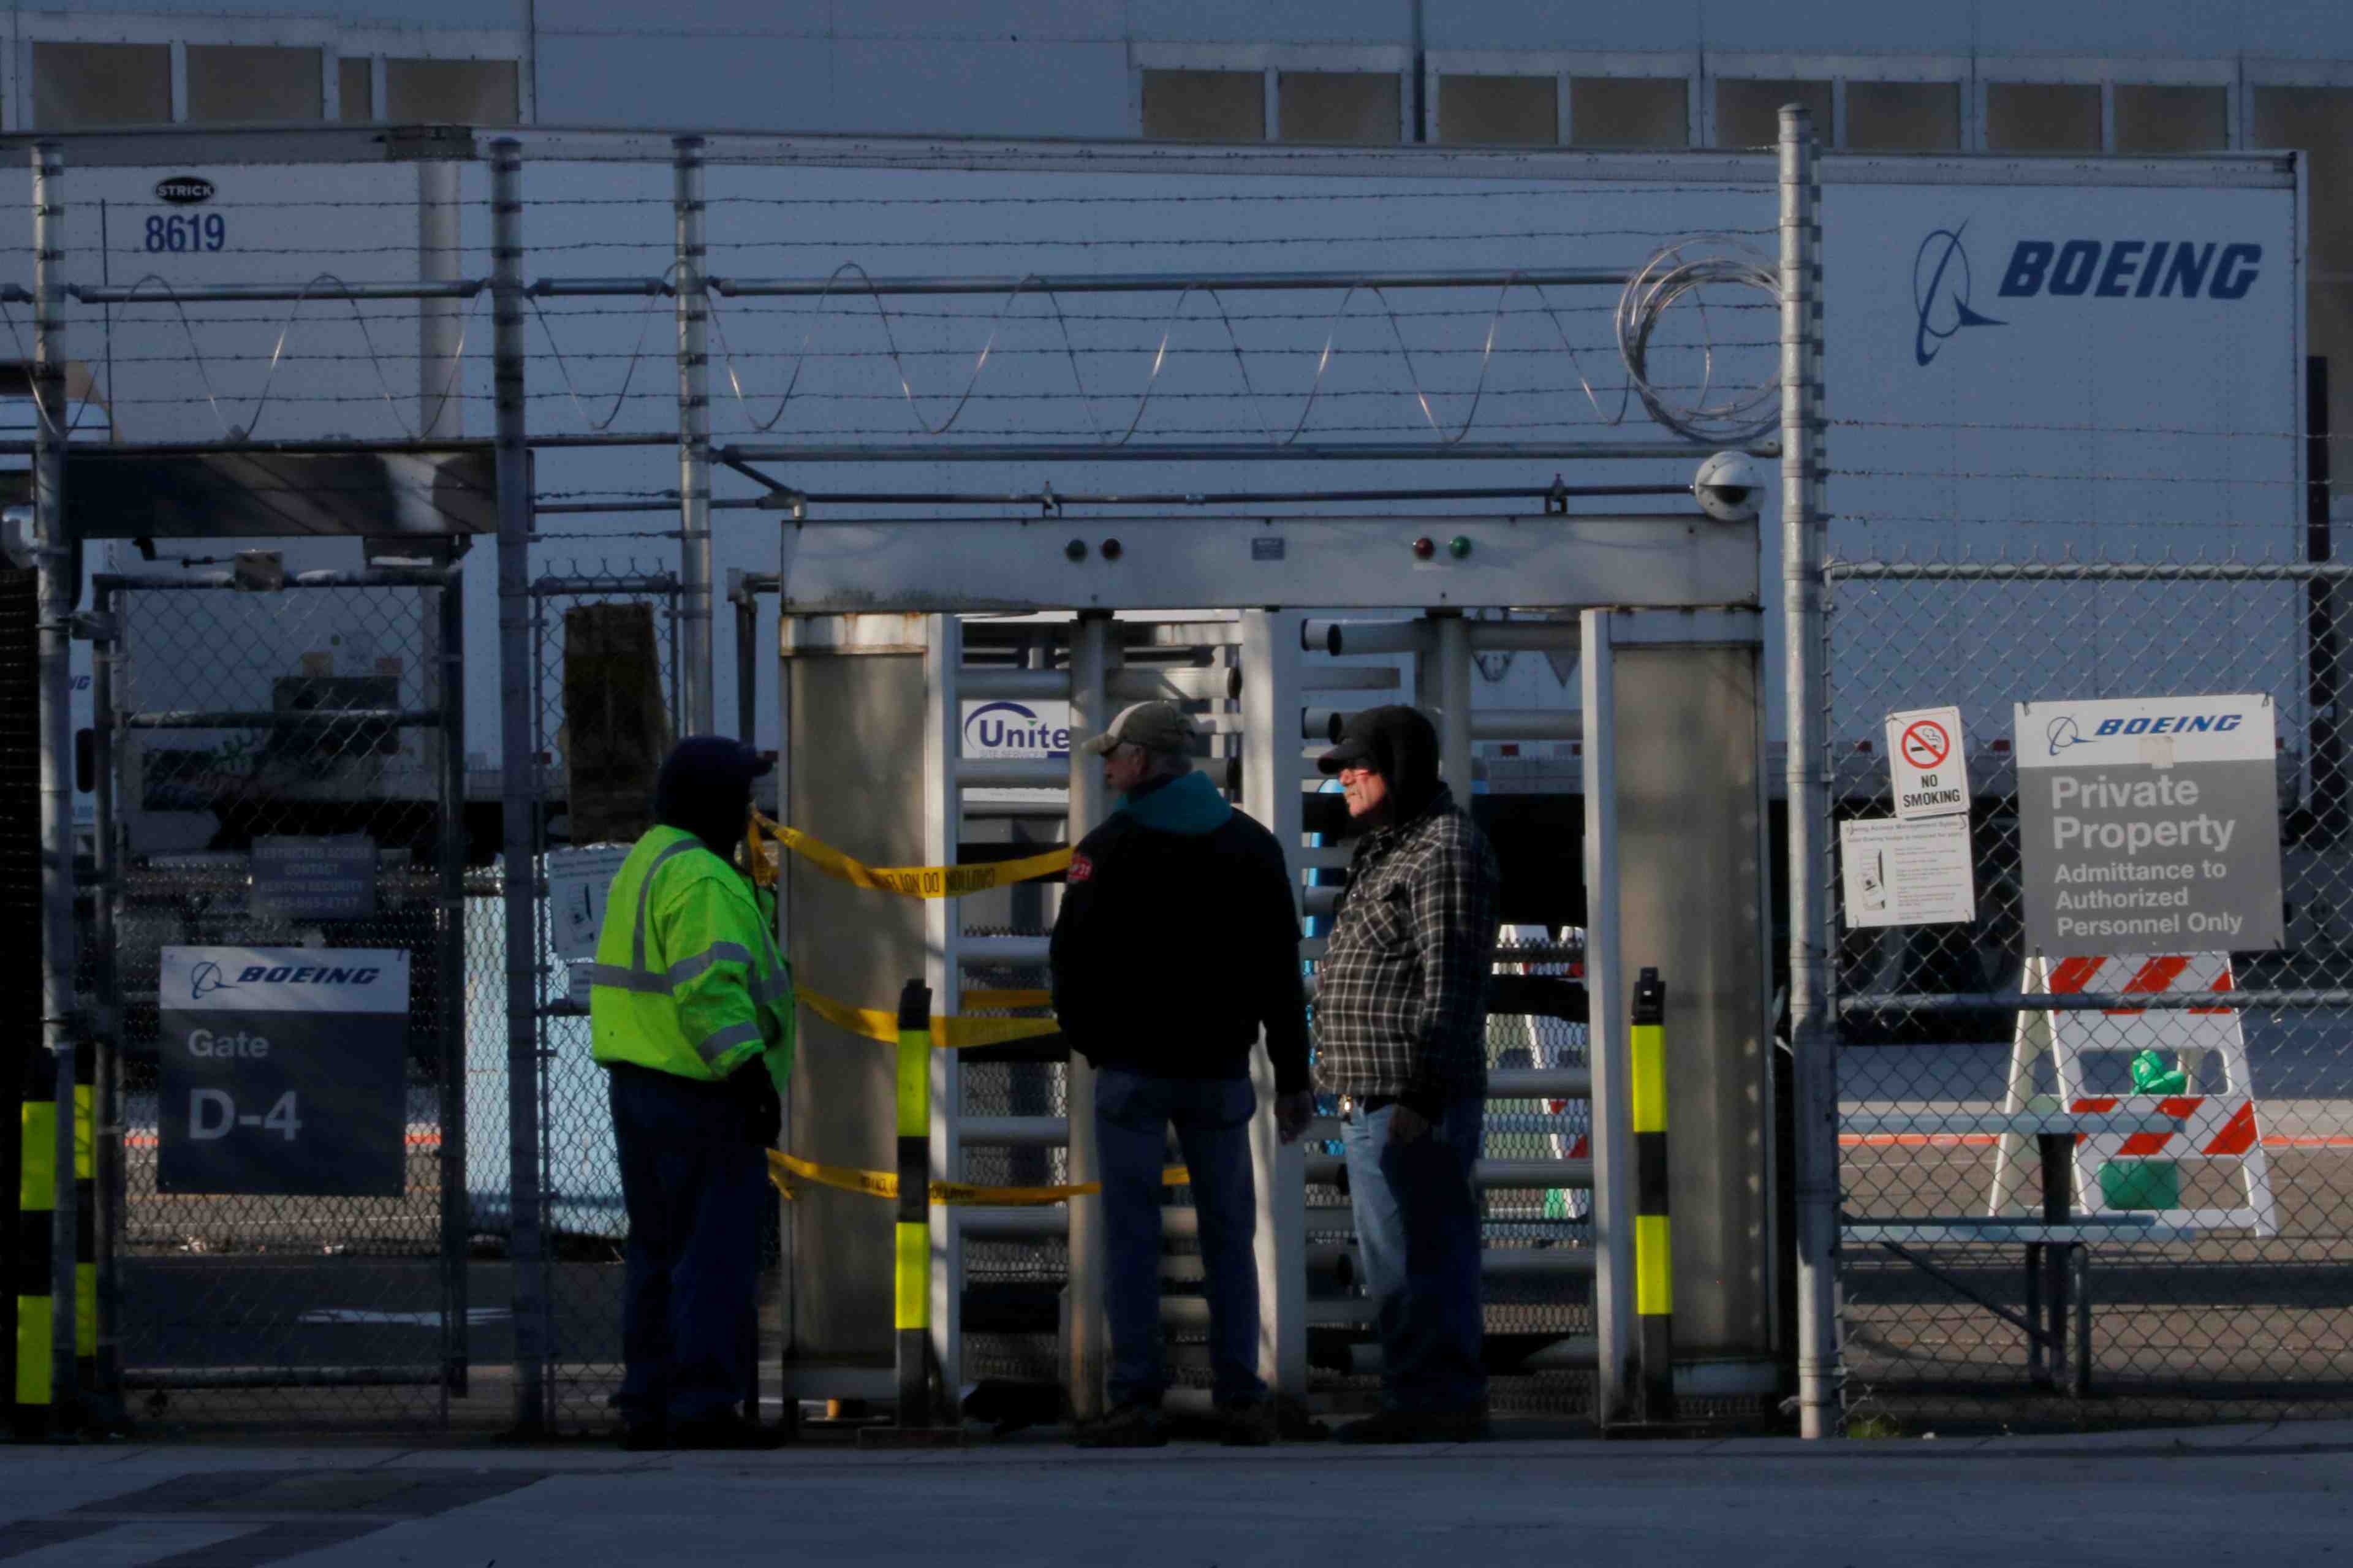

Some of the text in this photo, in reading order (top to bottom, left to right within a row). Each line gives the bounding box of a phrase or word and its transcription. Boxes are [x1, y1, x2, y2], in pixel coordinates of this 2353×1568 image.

[157, 185, 211, 197] STRICK
[145, 213, 225, 253] 8619
[1998, 240, 2262, 300] BOEING
[980, 720, 1069, 749] Unite
[2094, 714, 2243, 737] BOEING
[1921, 774, 1938, 788] NO
[2052, 775, 2199, 809] Private
[1903, 789, 1960, 808] SMOKING
[2053, 814, 2236, 855] Property
[284, 863, 339, 876] CONTACT
[2053, 859, 2227, 884] Admittance to
[923, 872, 941, 893] DO
[2055, 887, 2189, 910] Authorized
[2057, 911, 2243, 937] Personnel Only
[237, 964, 381, 986] BOEING
[188, 1029, 270, 1058] Gate
[189, 1088, 302, 1142] D-4
